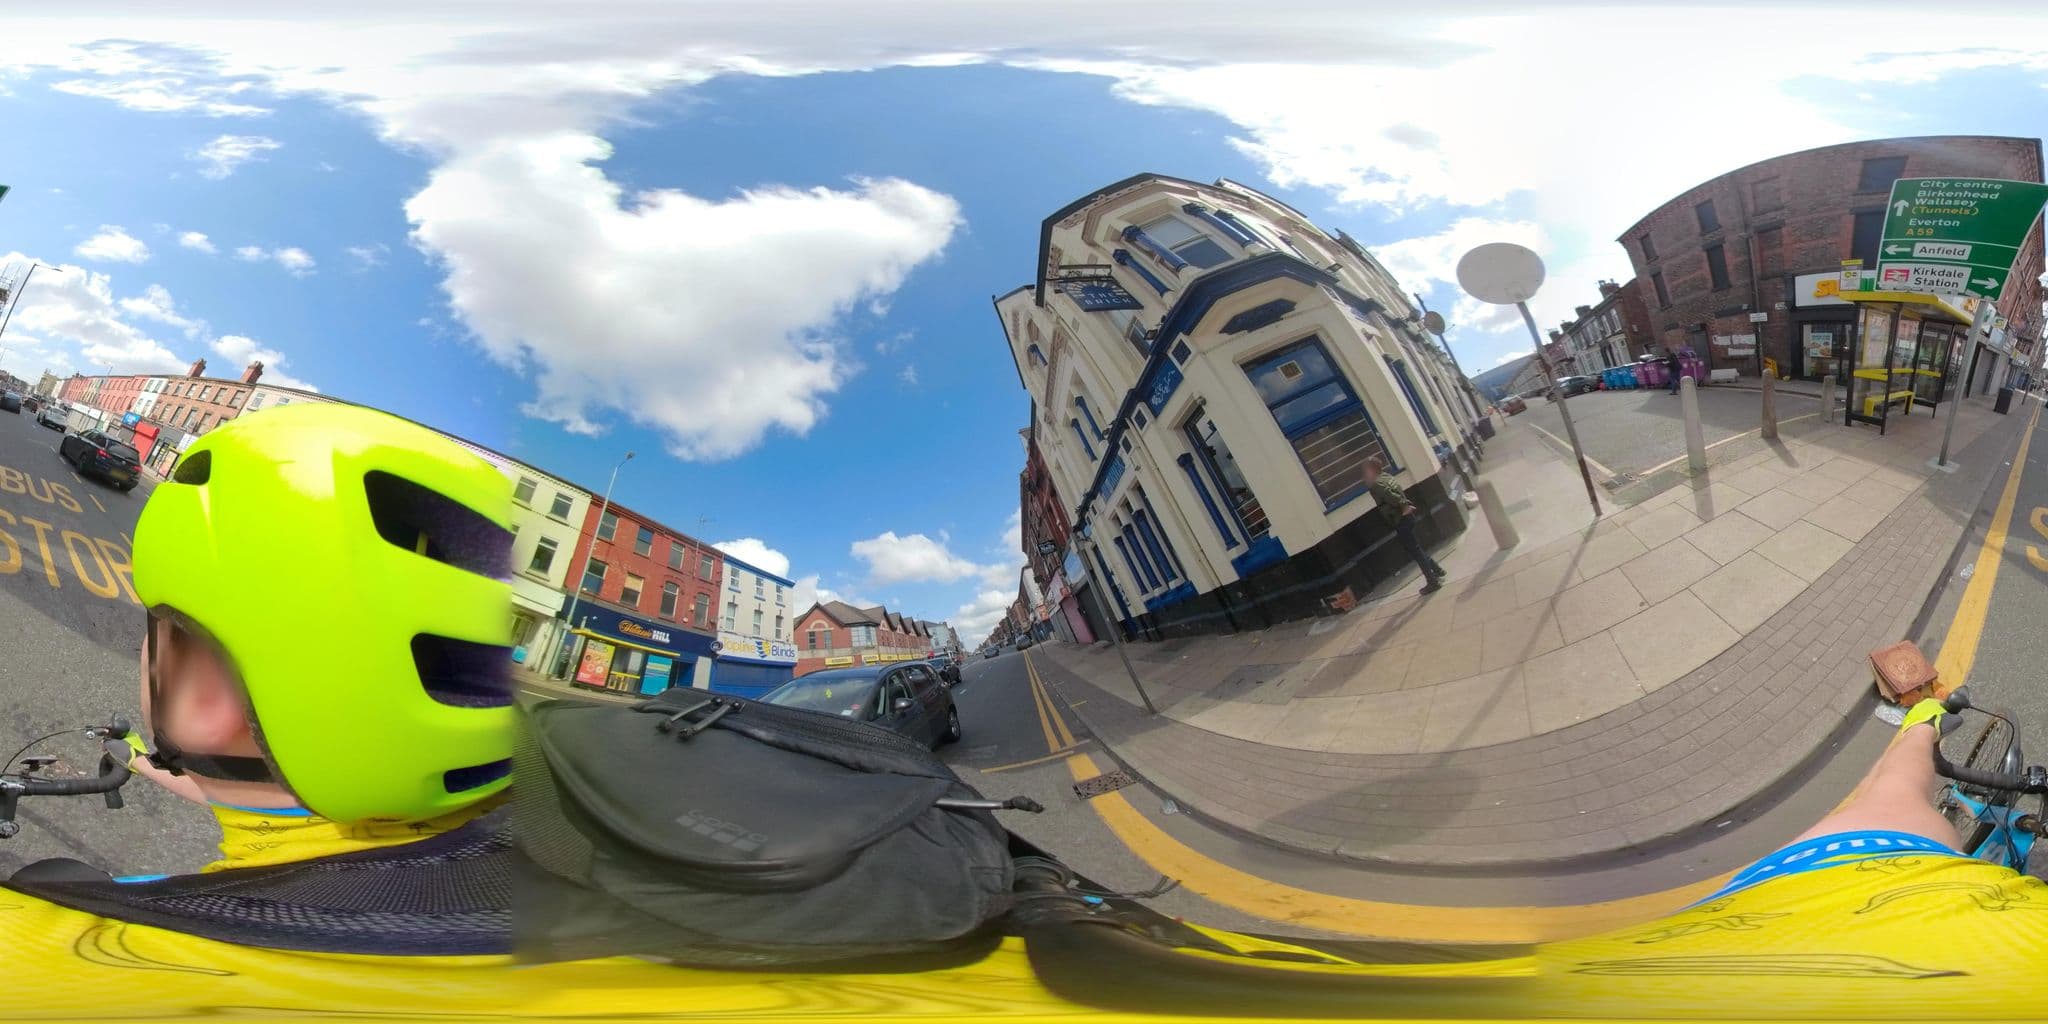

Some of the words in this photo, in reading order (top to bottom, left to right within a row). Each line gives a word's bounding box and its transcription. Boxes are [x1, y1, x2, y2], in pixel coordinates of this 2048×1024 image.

[1920, 180, 1950, 190] City
[1954, 181, 2003, 190] centre
[1917, 190, 2001, 200] Birkenhead
[1915, 198, 1977, 207] Wallasey
[1912, 206, 1979, 216] (Tunnels)
[1909, 218, 1961, 227] Everton
[1919, 246, 1966, 257] Anfield
[1913, 267, 1964, 279] Kirkdale
[1914, 278, 1959, 289] Station
[0, 465, 83, 512] BUS
[652, 630, 670, 644] HILL
[771, 645, 796, 658] Blinds
